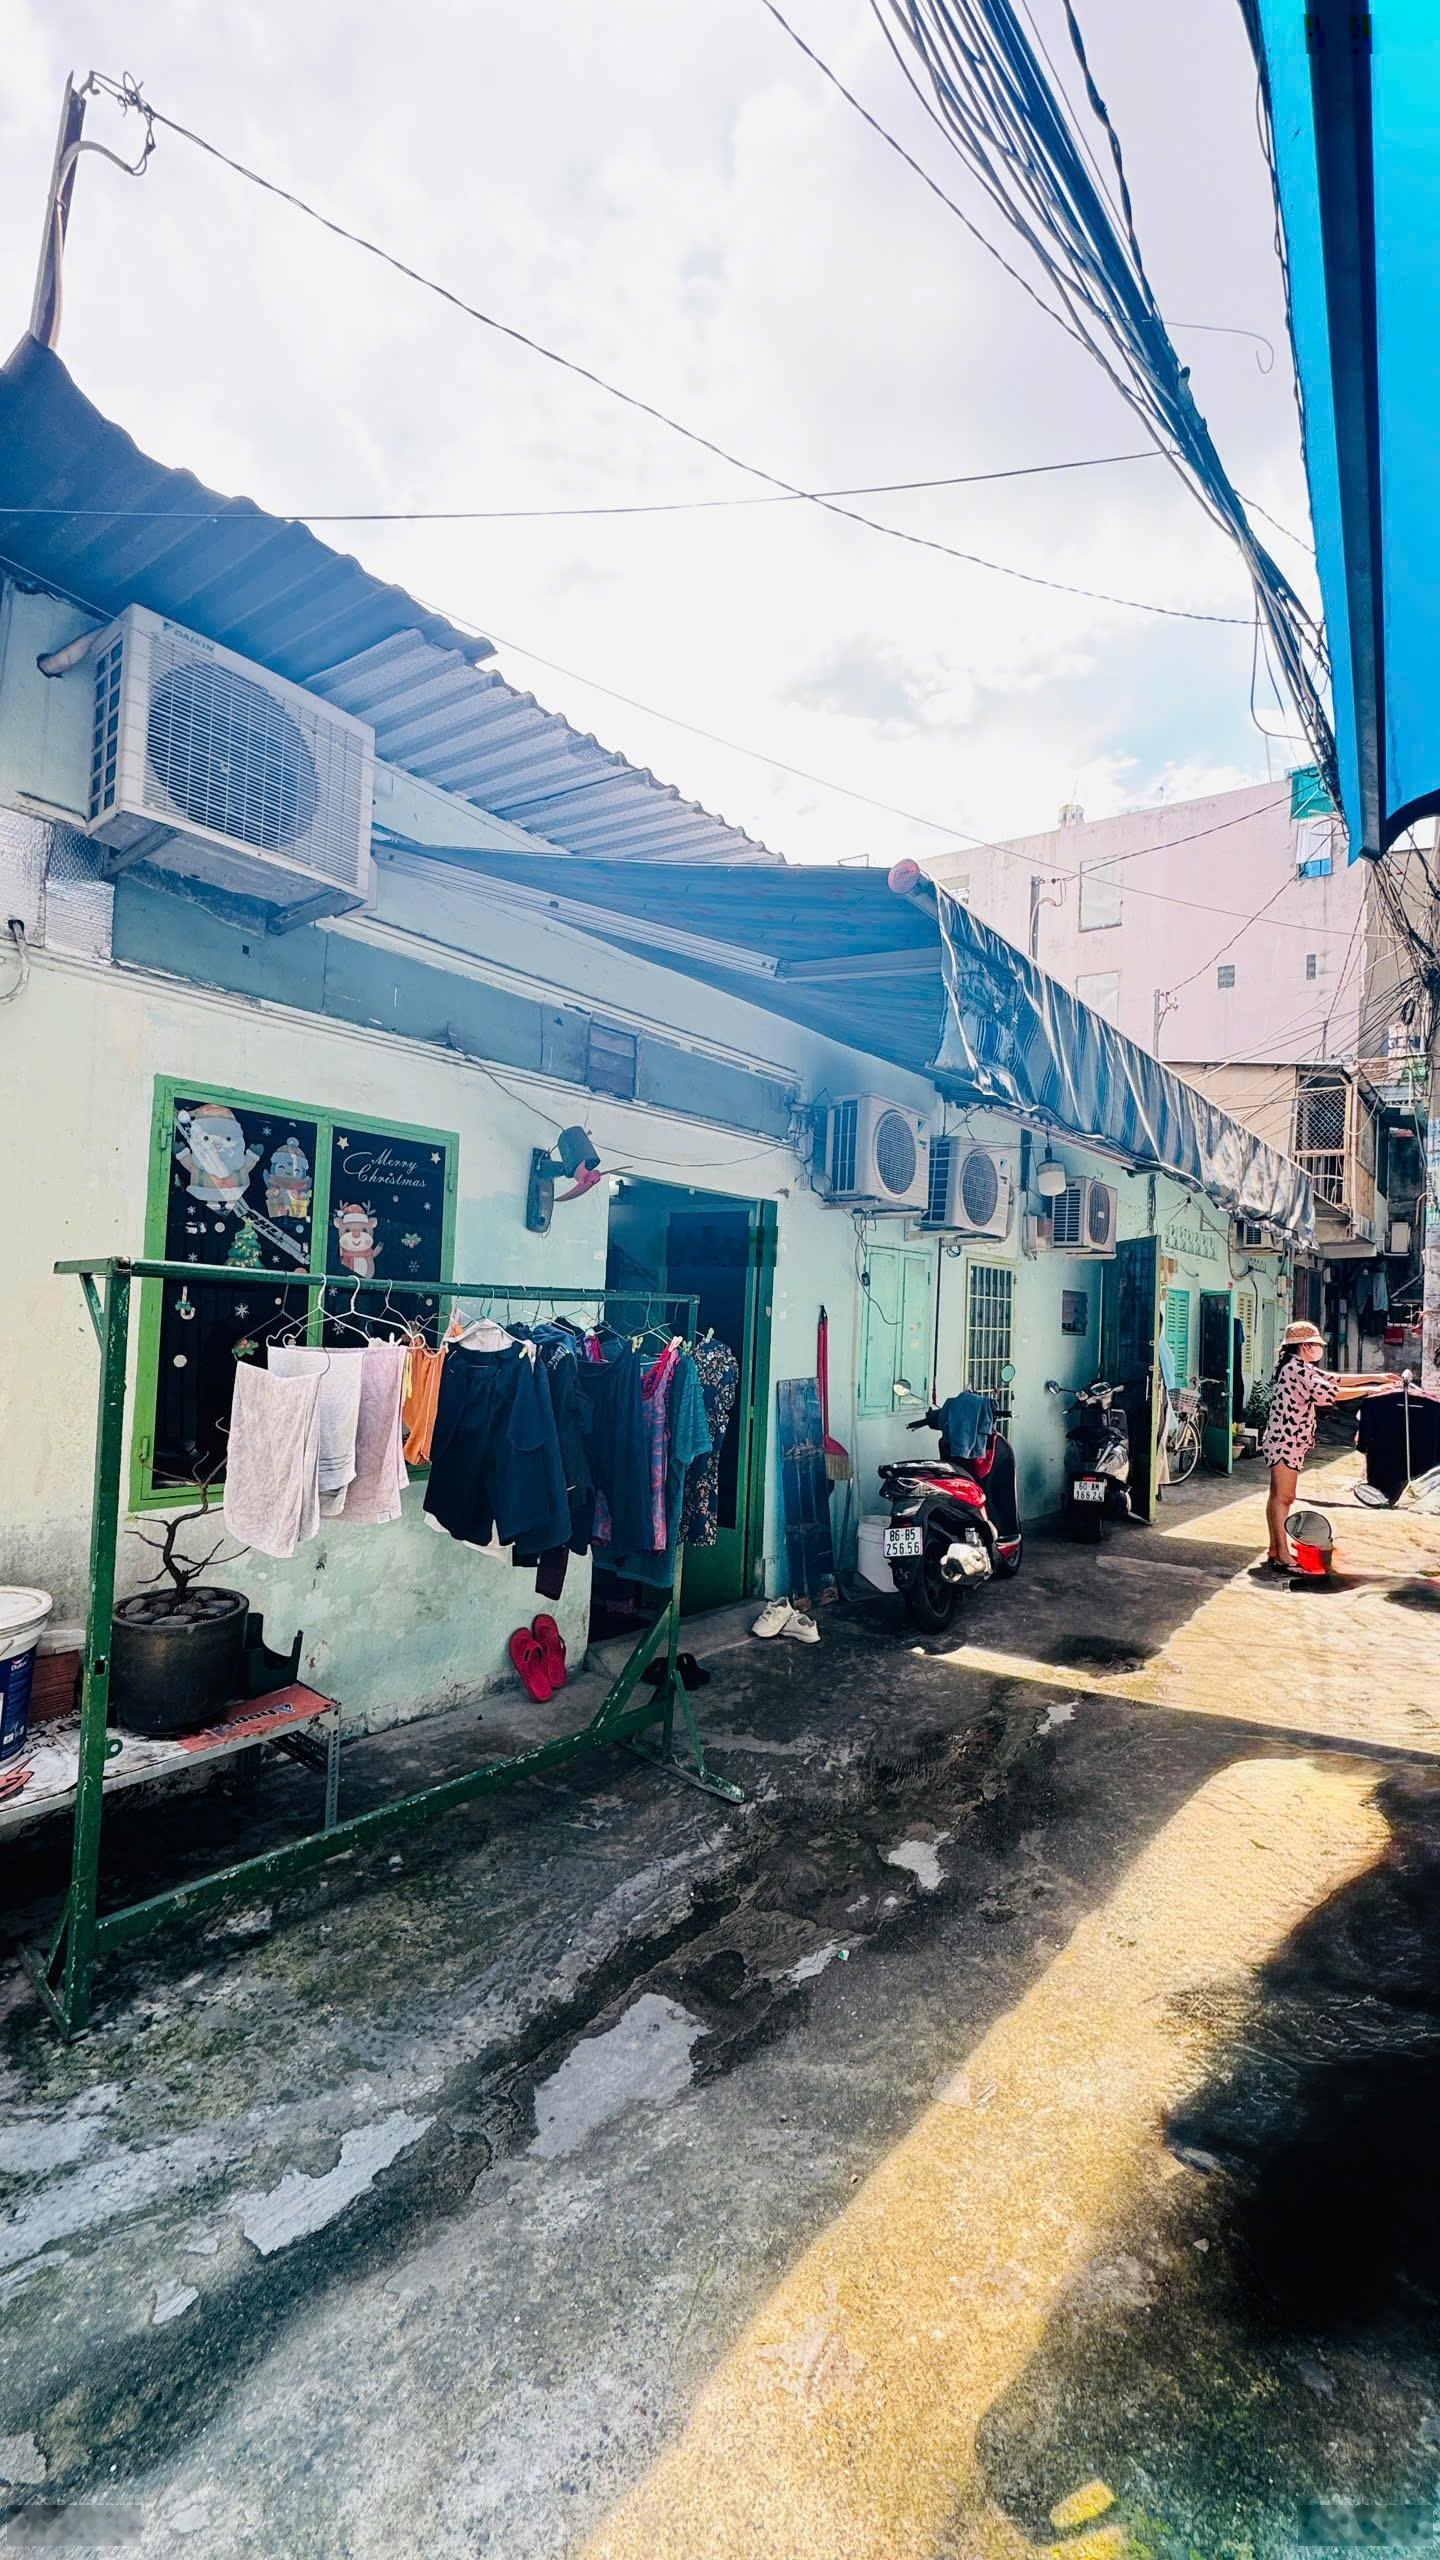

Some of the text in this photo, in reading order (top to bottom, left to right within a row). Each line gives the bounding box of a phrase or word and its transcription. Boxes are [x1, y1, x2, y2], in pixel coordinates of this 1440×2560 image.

[174, 629, 215, 652] DAIKIN
[343, 1152, 428, 1188] Christmas
[371, 1148, 419, 1174] Merry
[889, 1528, 916, 1541] 86-B5
